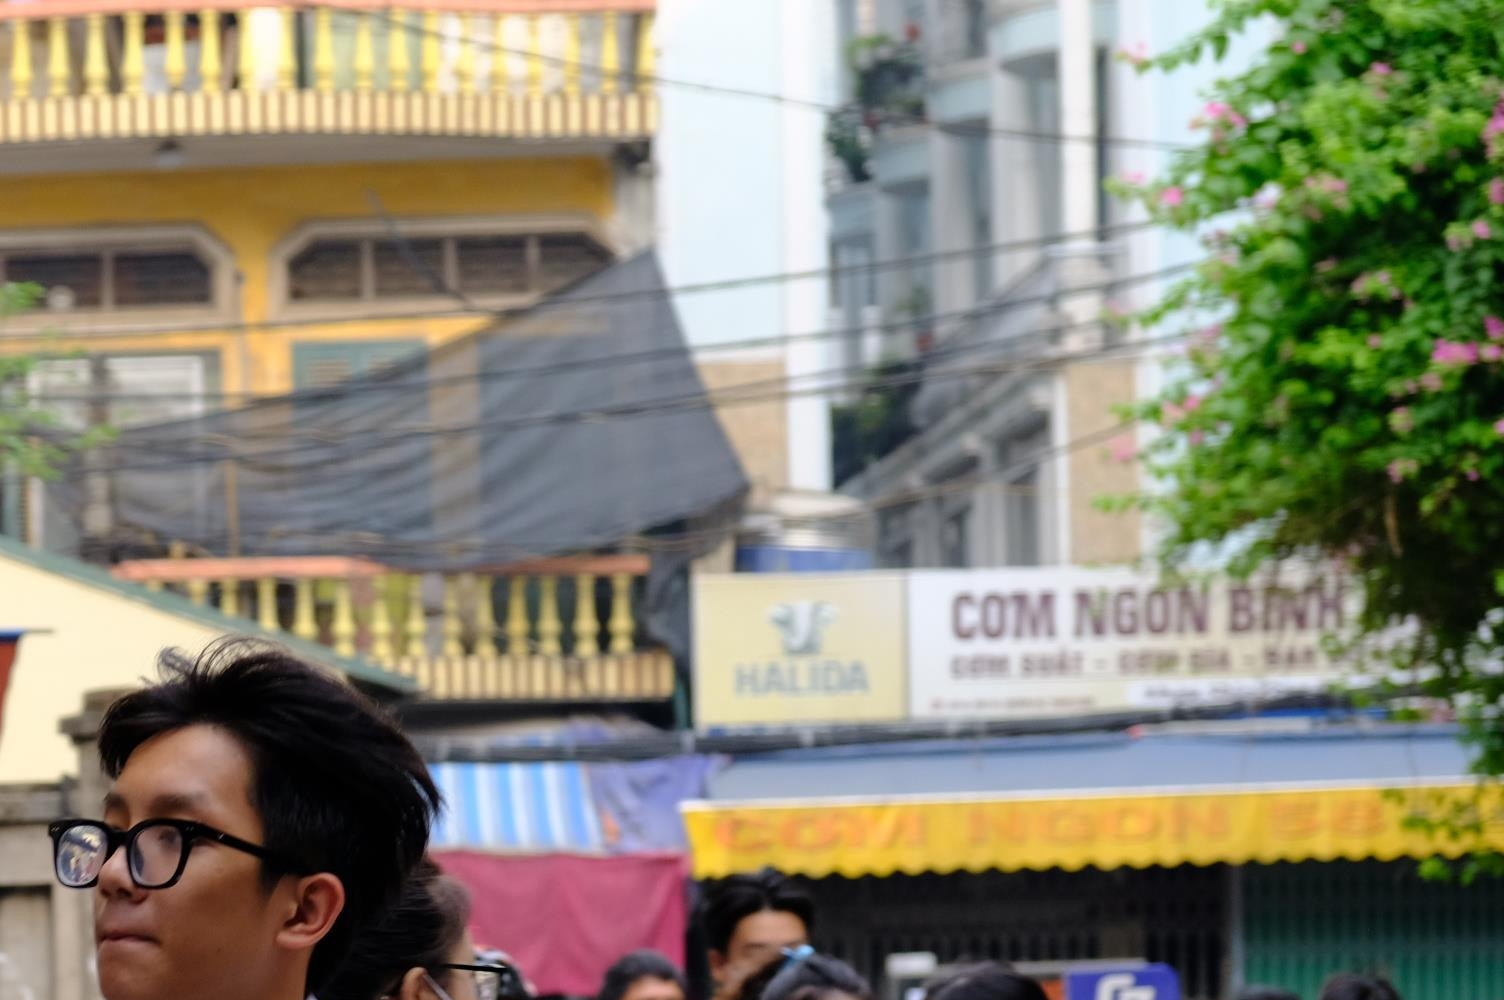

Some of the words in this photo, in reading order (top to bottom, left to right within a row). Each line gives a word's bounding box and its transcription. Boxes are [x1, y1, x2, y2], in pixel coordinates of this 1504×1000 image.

[1072, 586, 1211, 638] NGON
[734, 659, 870, 696] HALIDA
[967, 797, 1228, 845] NGON
